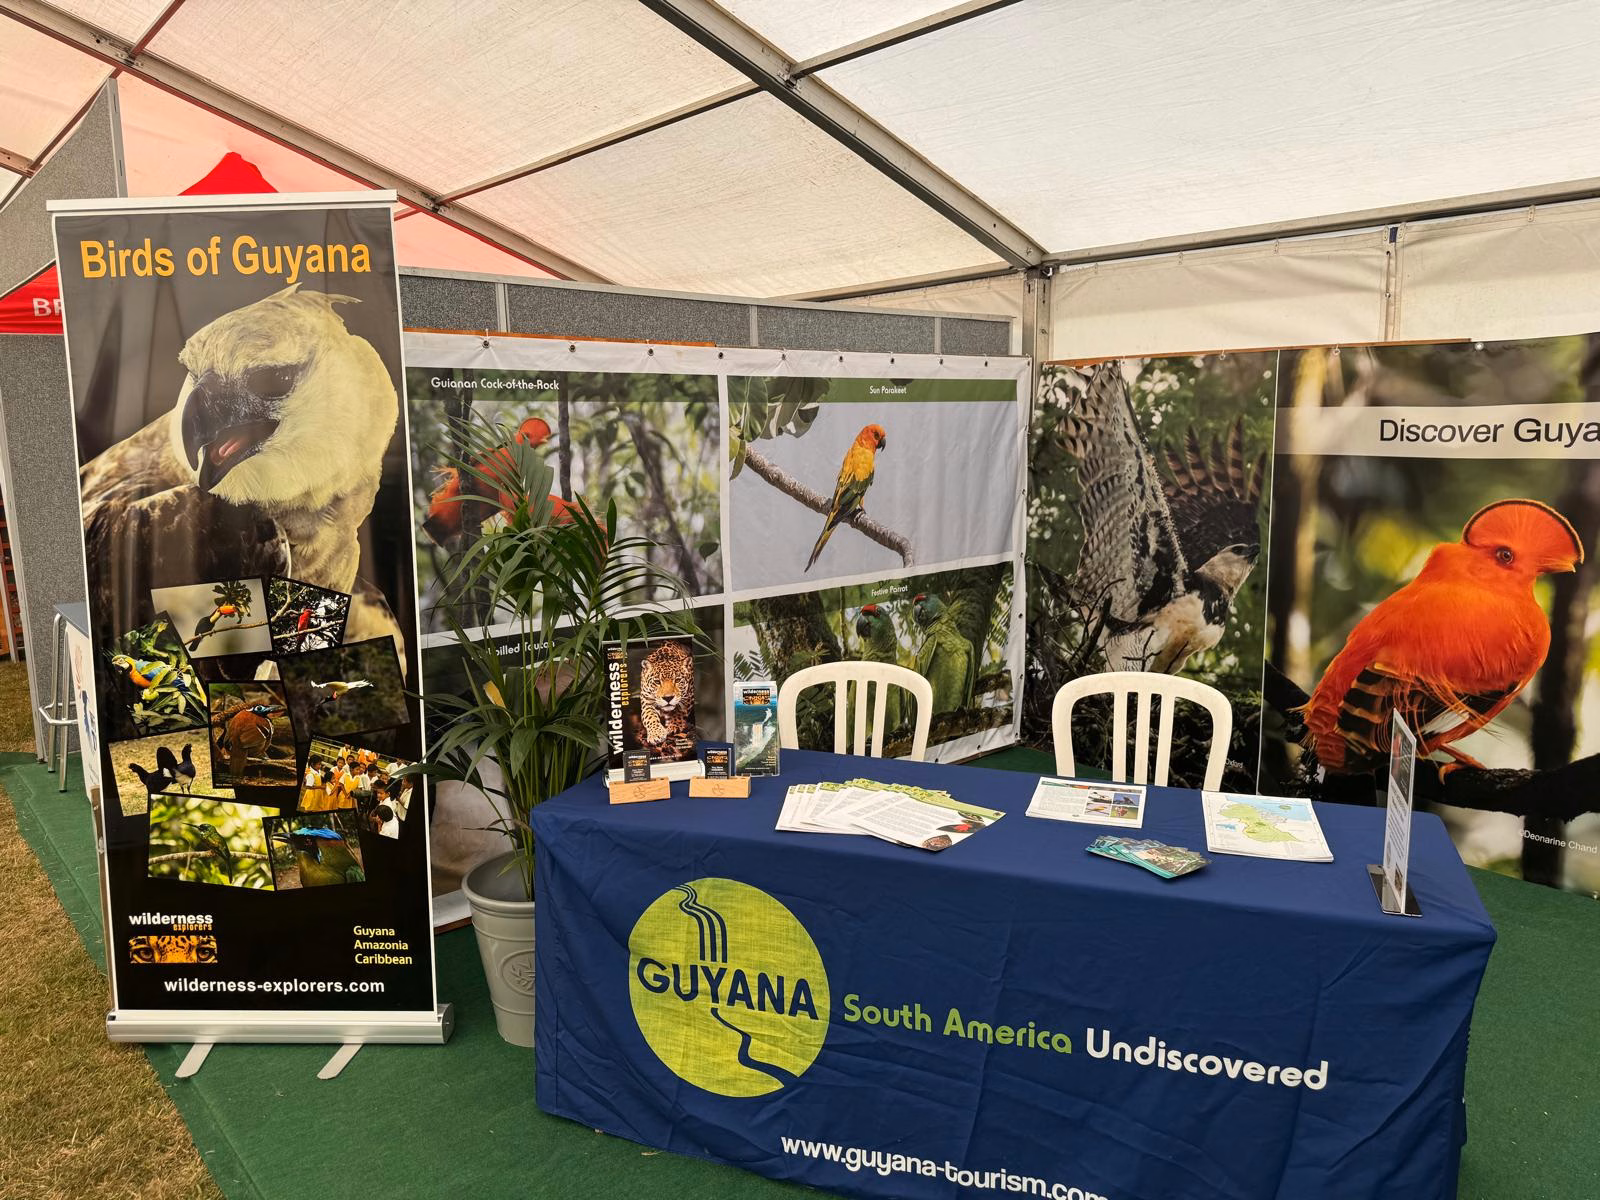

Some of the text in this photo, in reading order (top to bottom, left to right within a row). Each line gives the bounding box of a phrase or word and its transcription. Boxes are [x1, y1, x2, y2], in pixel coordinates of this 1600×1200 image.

[80, 235, 371, 284] Birds of Guyana
[431, 377, 560, 390] Guianan Cock-of-the-Rock
[869, 385, 907, 394] Sun Parakeet
[1380, 418, 1600, 448] Discover Guya
[871, 585, 909, 597] Festive Parrot
[620, 663, 631, 706] explorers
[608, 662, 624, 755] wilderness
[1568, 841, 1598, 853] Chand
[128, 912, 213, 925] wilderness
[173, 922, 213, 932] explorers
[353, 925, 395, 938] Guyana
[353, 940, 409, 950] Amazonia
[354, 953, 413, 965] Caribbean
[164, 978, 385, 995] wilderness-explorers.com
[636, 957, 819, 1020] GUYANA
[843, 993, 1328, 1091] South America Undiscovered
